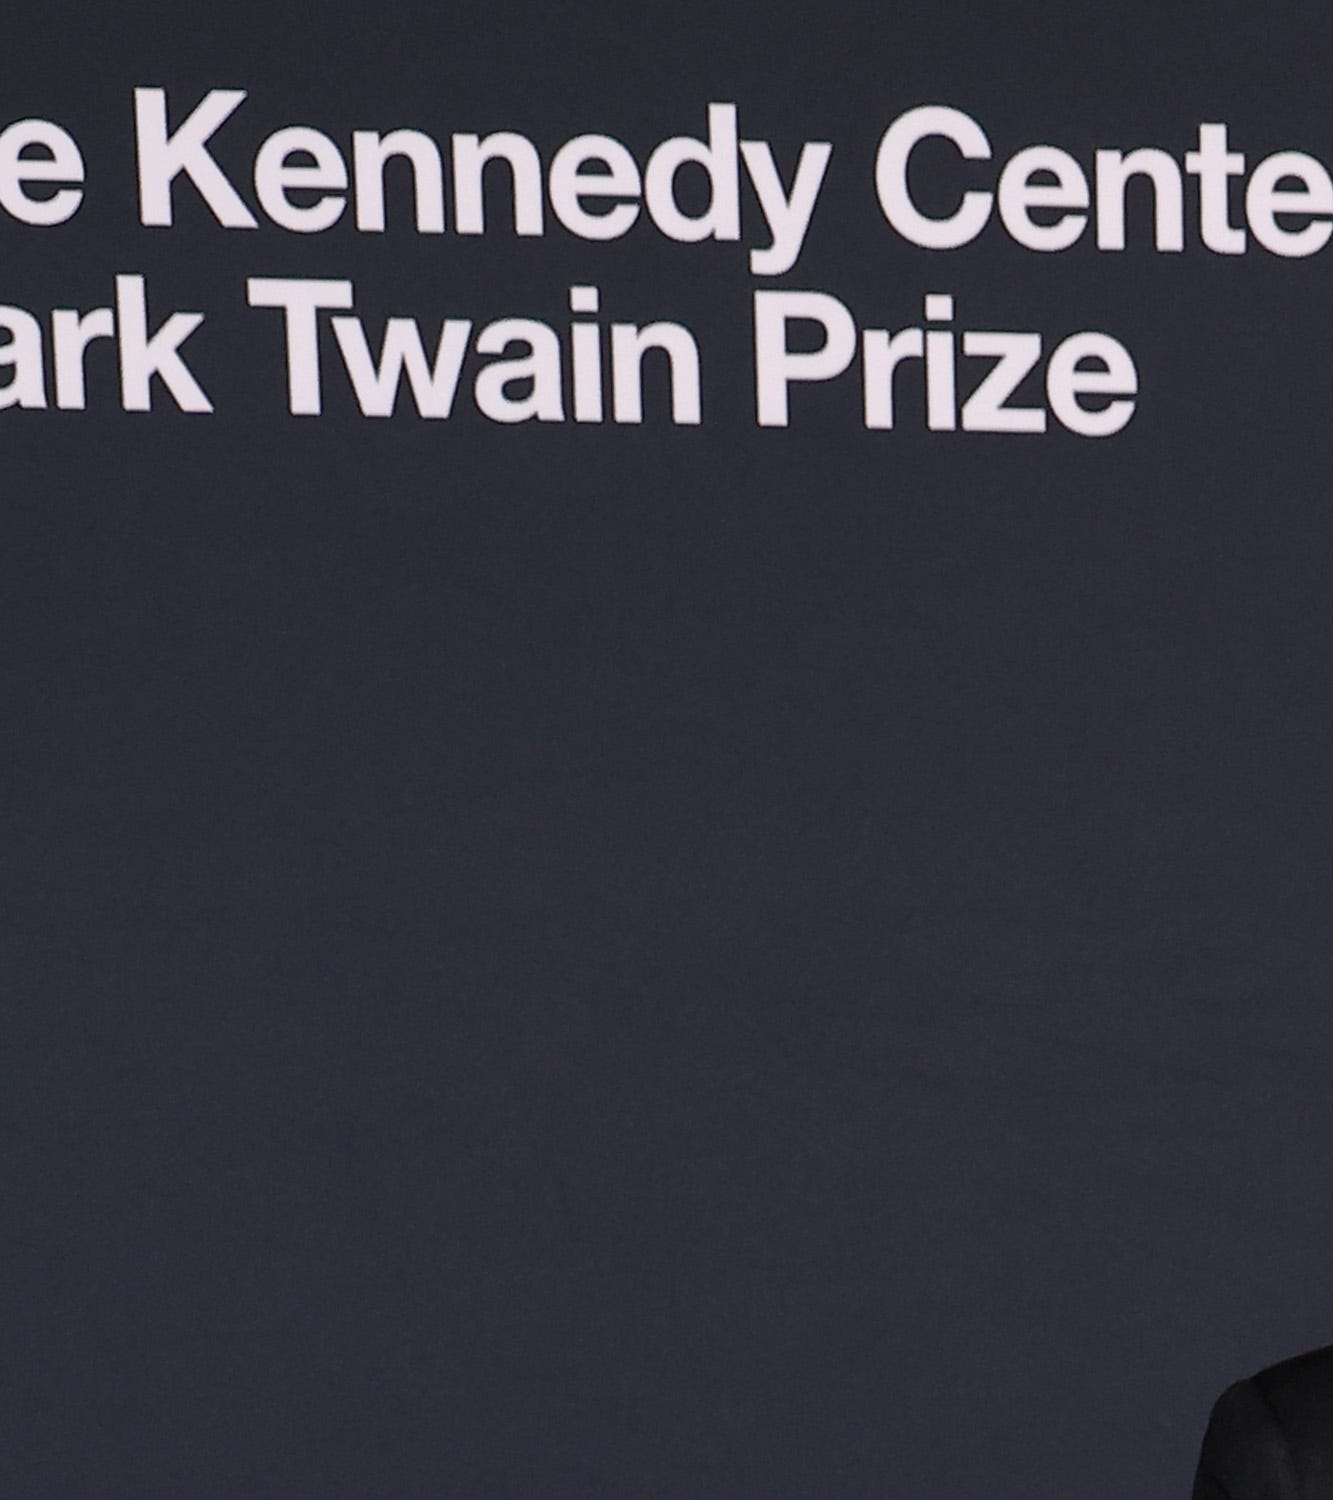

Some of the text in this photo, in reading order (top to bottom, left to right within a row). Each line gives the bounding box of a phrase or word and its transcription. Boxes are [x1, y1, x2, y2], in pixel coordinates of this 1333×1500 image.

[134, 87, 833, 276] Kennedy
[0, 274, 1139, 437] ark Twain Prize
